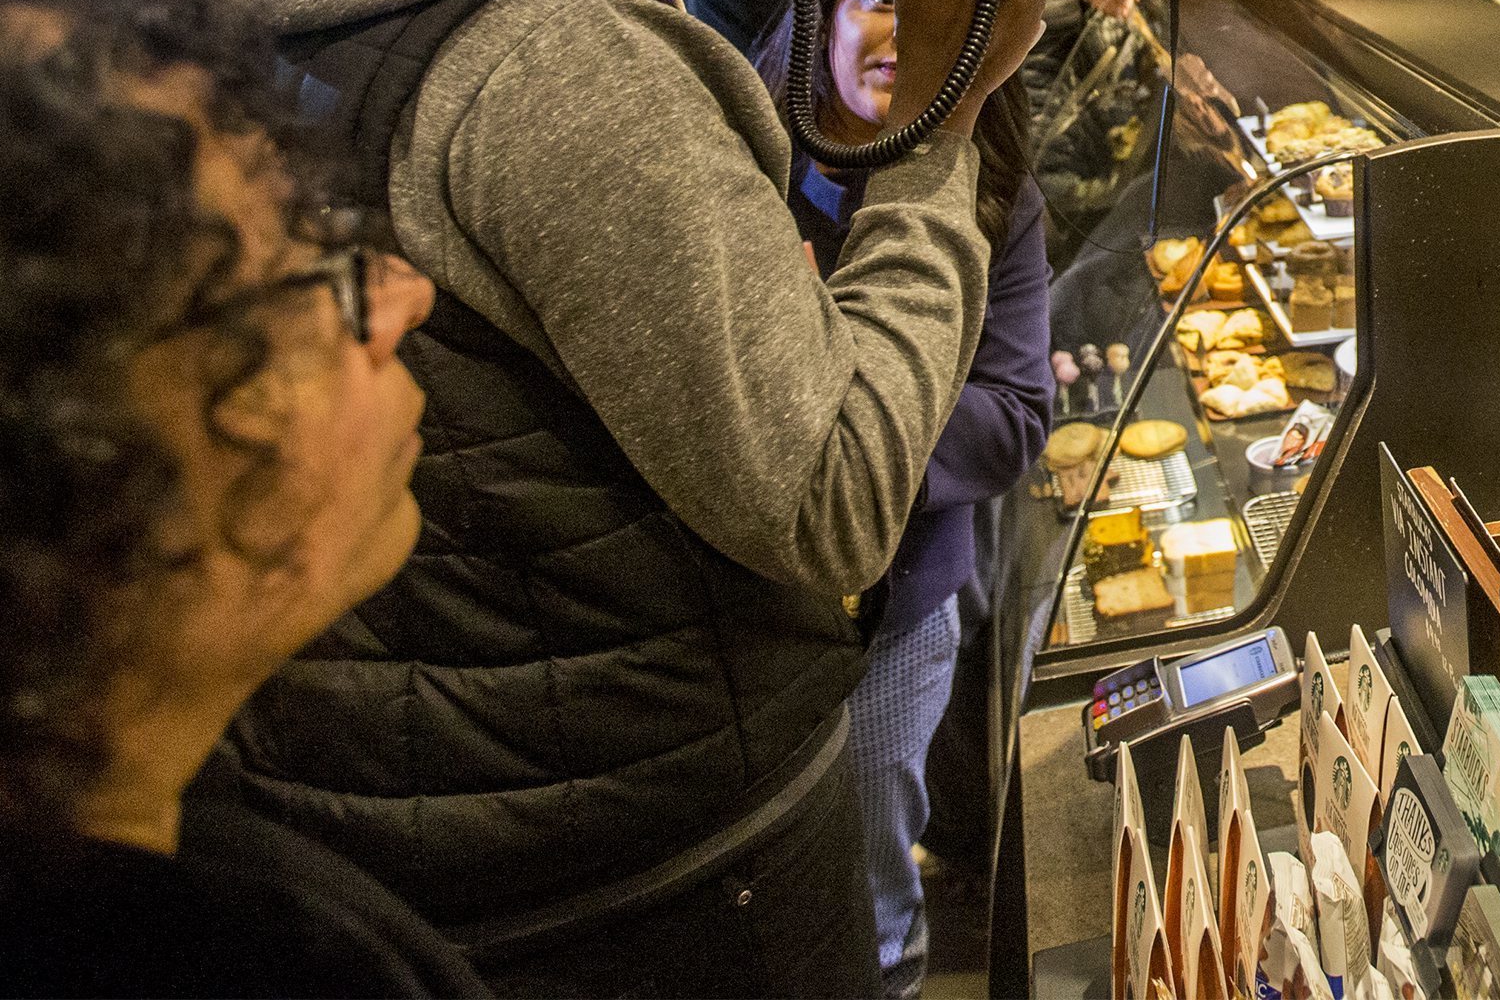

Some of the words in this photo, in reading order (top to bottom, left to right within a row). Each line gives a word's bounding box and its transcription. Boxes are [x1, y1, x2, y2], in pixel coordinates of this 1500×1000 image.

[1390, 493, 1406, 538] VIA
[1407, 520, 1447, 607] INSTANT
[1449, 716, 1490, 802] STARBUCKS
[1397, 792, 1435, 855] THANKS
